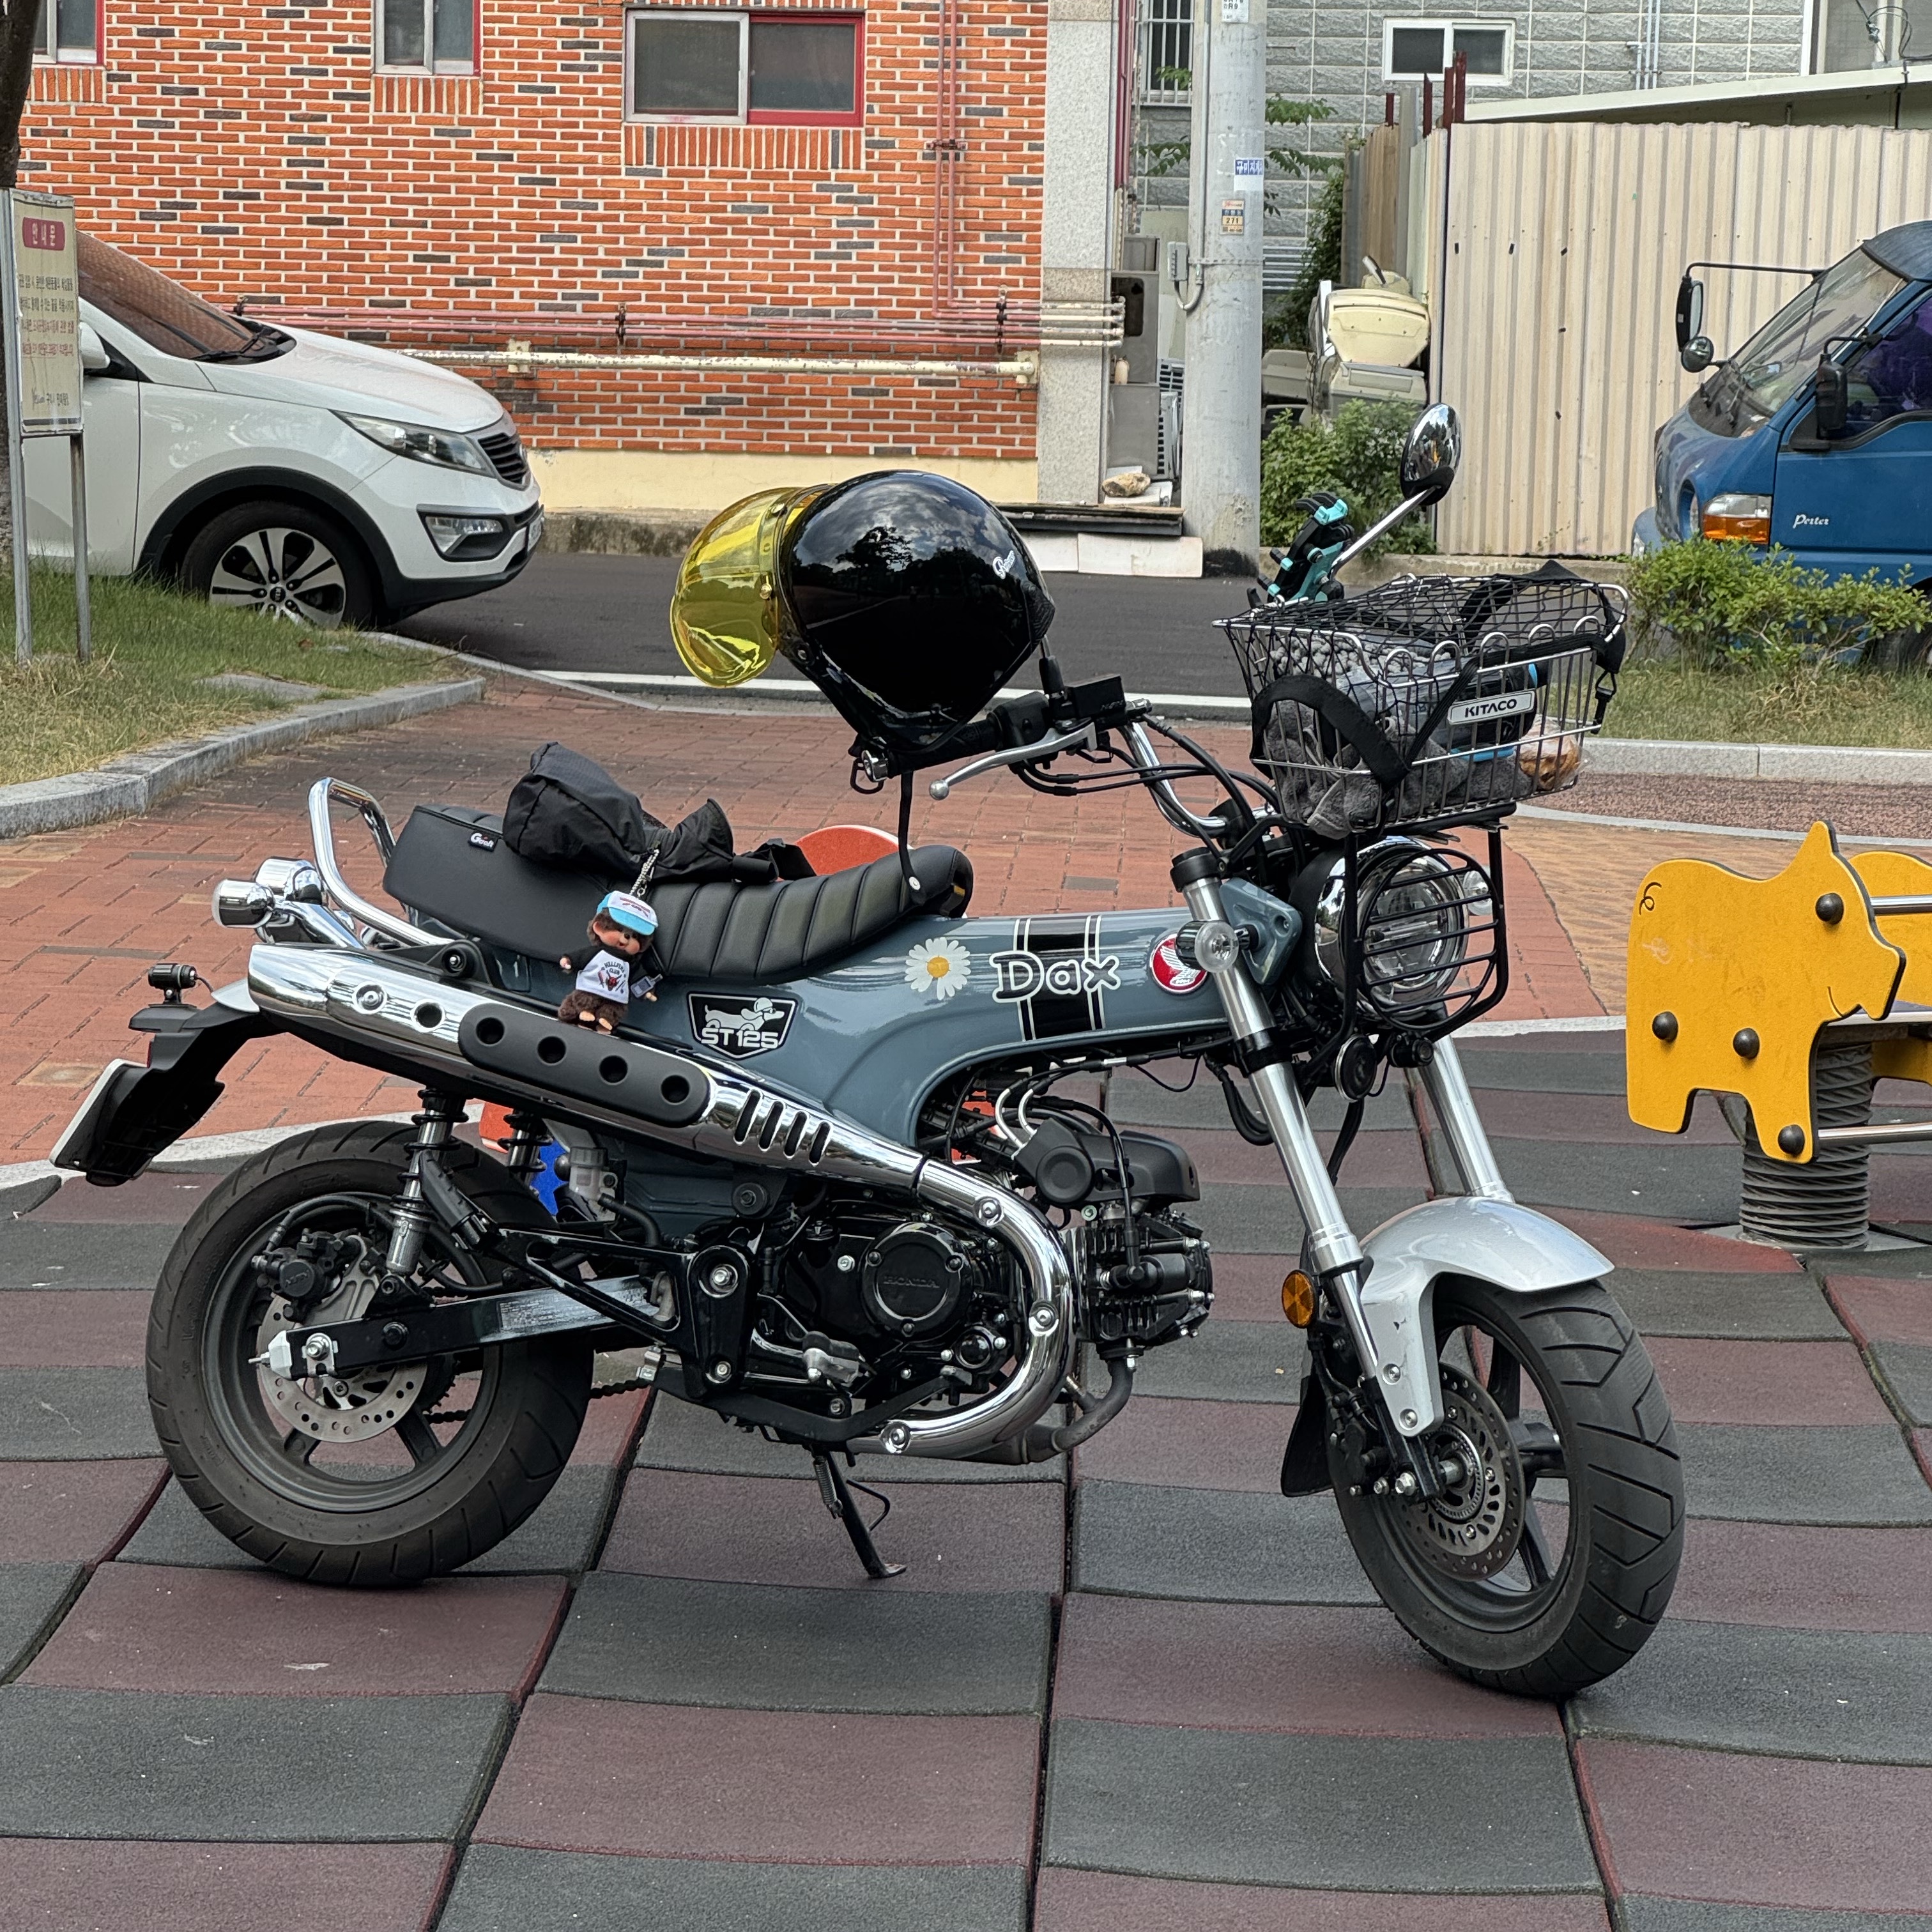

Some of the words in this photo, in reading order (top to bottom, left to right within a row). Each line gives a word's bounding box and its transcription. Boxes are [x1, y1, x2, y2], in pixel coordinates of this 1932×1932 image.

[32, 222, 56, 247] 안내문
[1465, 699, 1517, 717] KITACO
[990, 950, 1121, 1003] Dax
[701, 1027, 778, 1048] ST125
